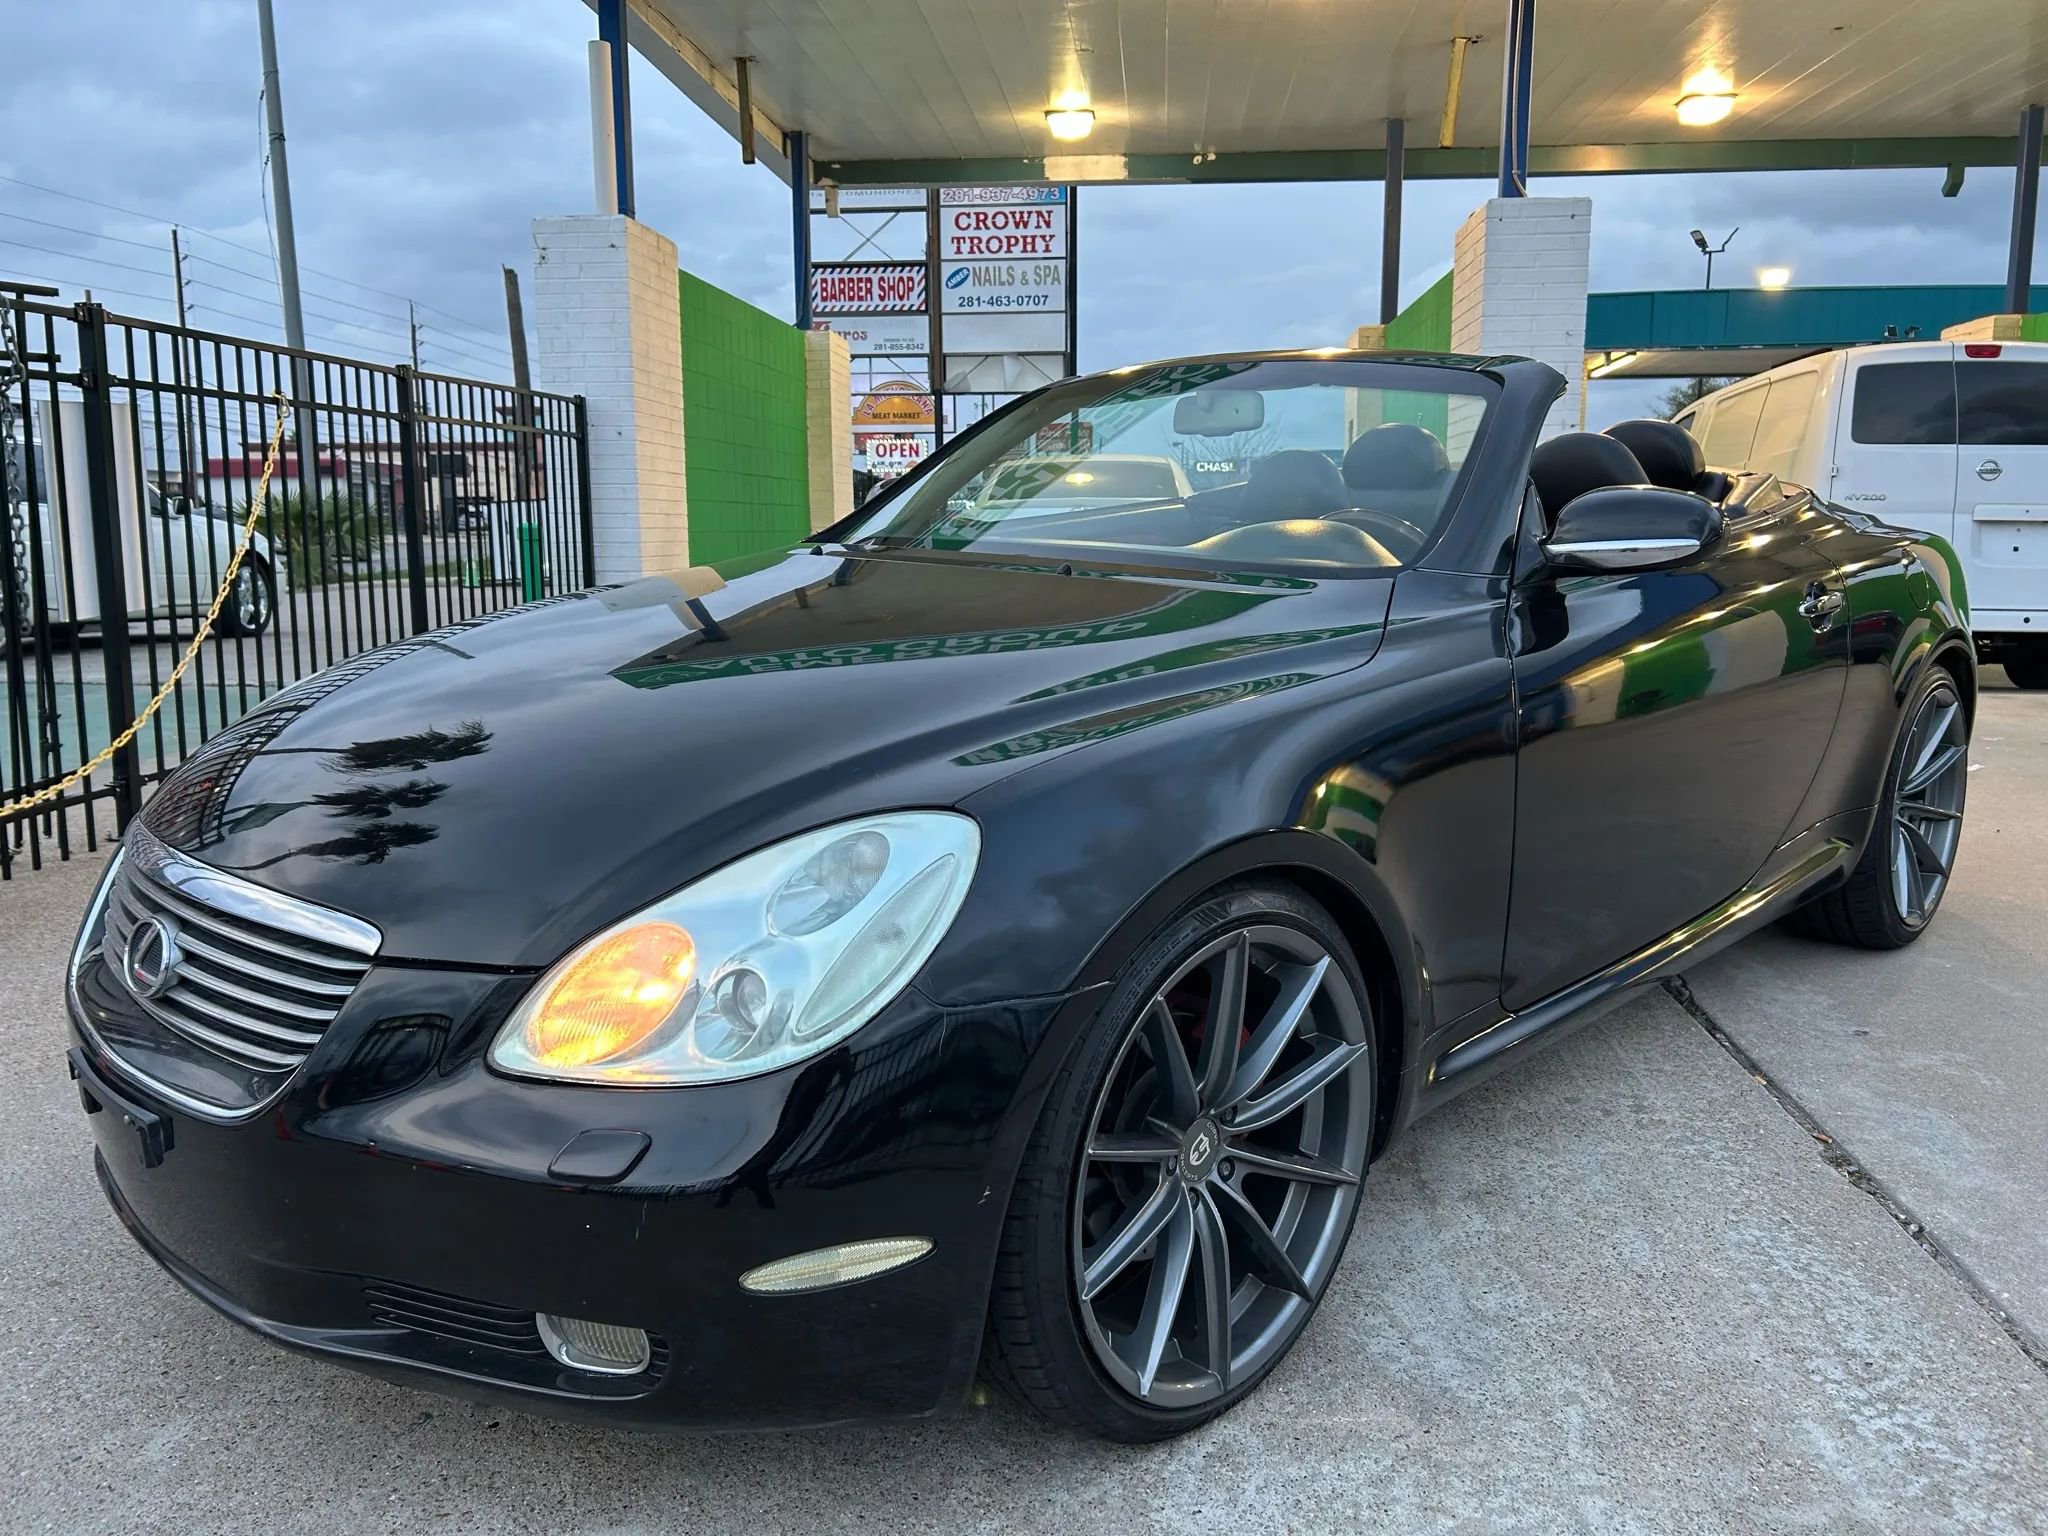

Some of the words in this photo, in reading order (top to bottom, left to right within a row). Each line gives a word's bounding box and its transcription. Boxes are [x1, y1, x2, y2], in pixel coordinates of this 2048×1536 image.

[943, 187, 1060, 203] 281-937-4973
[954, 210, 1053, 231] CROWN
[951, 234, 1055, 255] TROPHY
[972, 265, 1015, 287] NAILS
[1020, 270, 1029, 286] &
[1034, 264, 1061, 286] SPA
[820, 277, 873, 302] BARBER
[878, 275, 915, 302] SHOP
[958, 294, 1049, 308] 281-463-0707
[863, 403, 876, 416] LA
[875, 443, 920, 458] OPEN
